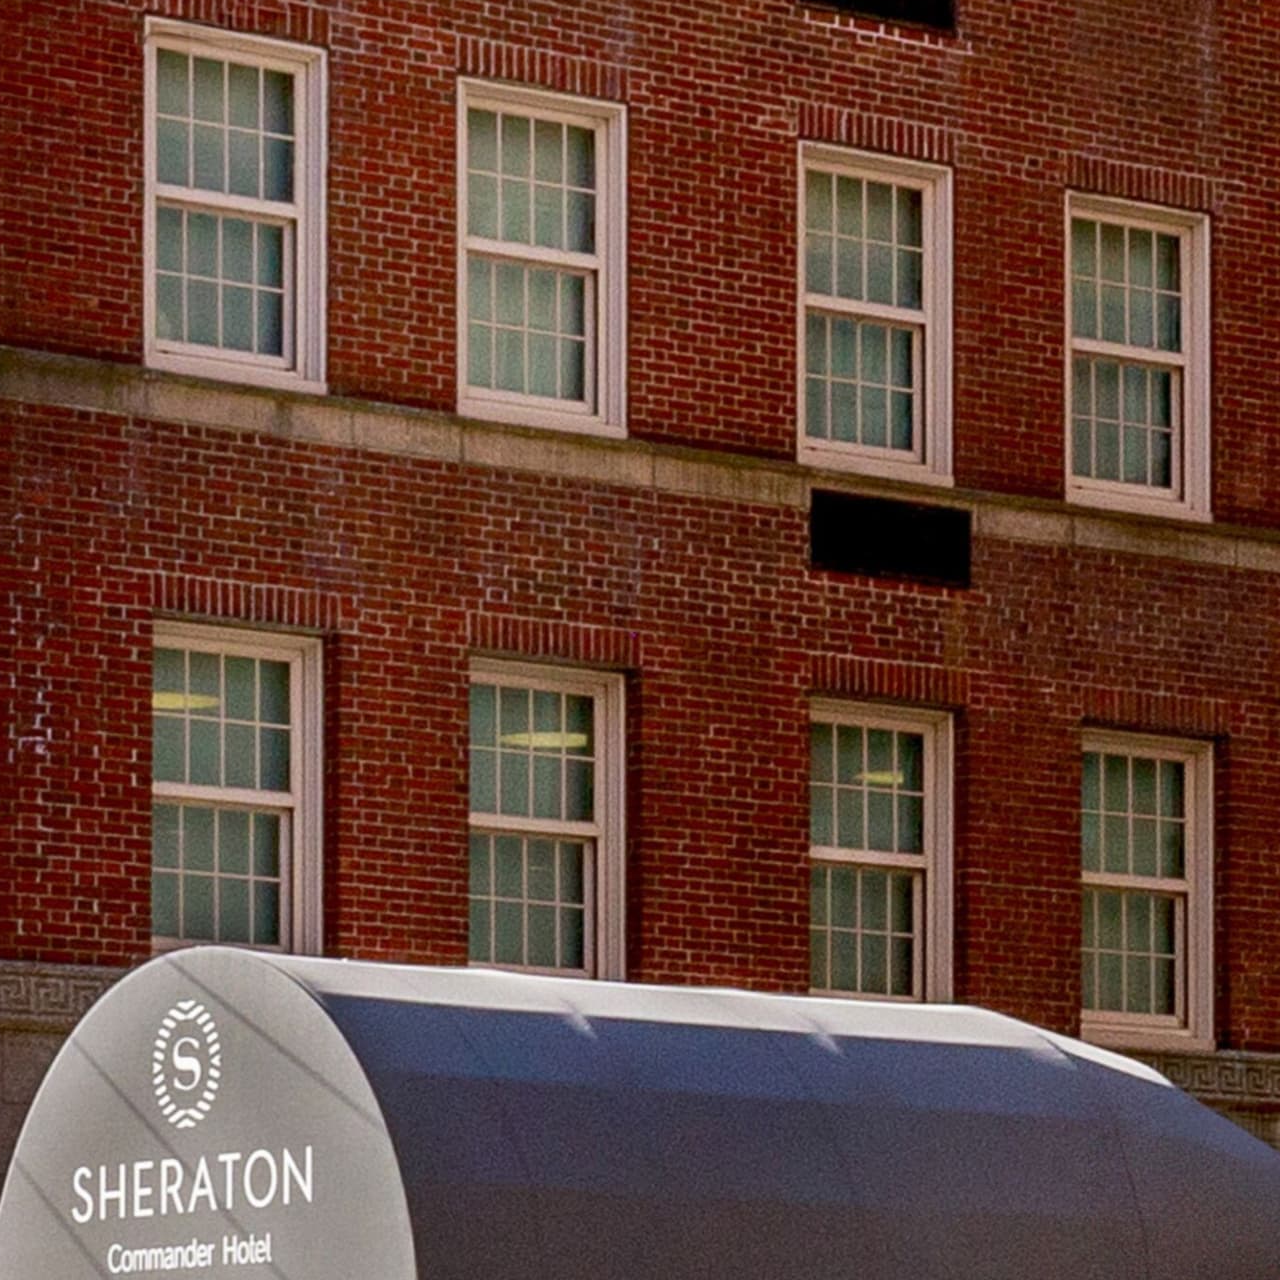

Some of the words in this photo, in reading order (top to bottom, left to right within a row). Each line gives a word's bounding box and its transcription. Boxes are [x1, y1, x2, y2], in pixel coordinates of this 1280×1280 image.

[171, 1036, 202, 1091] S
[70, 1145, 314, 1223] SHERATON
[107, 1238, 216, 1273] Commander
[222, 1232, 272, 1265] Hotel
